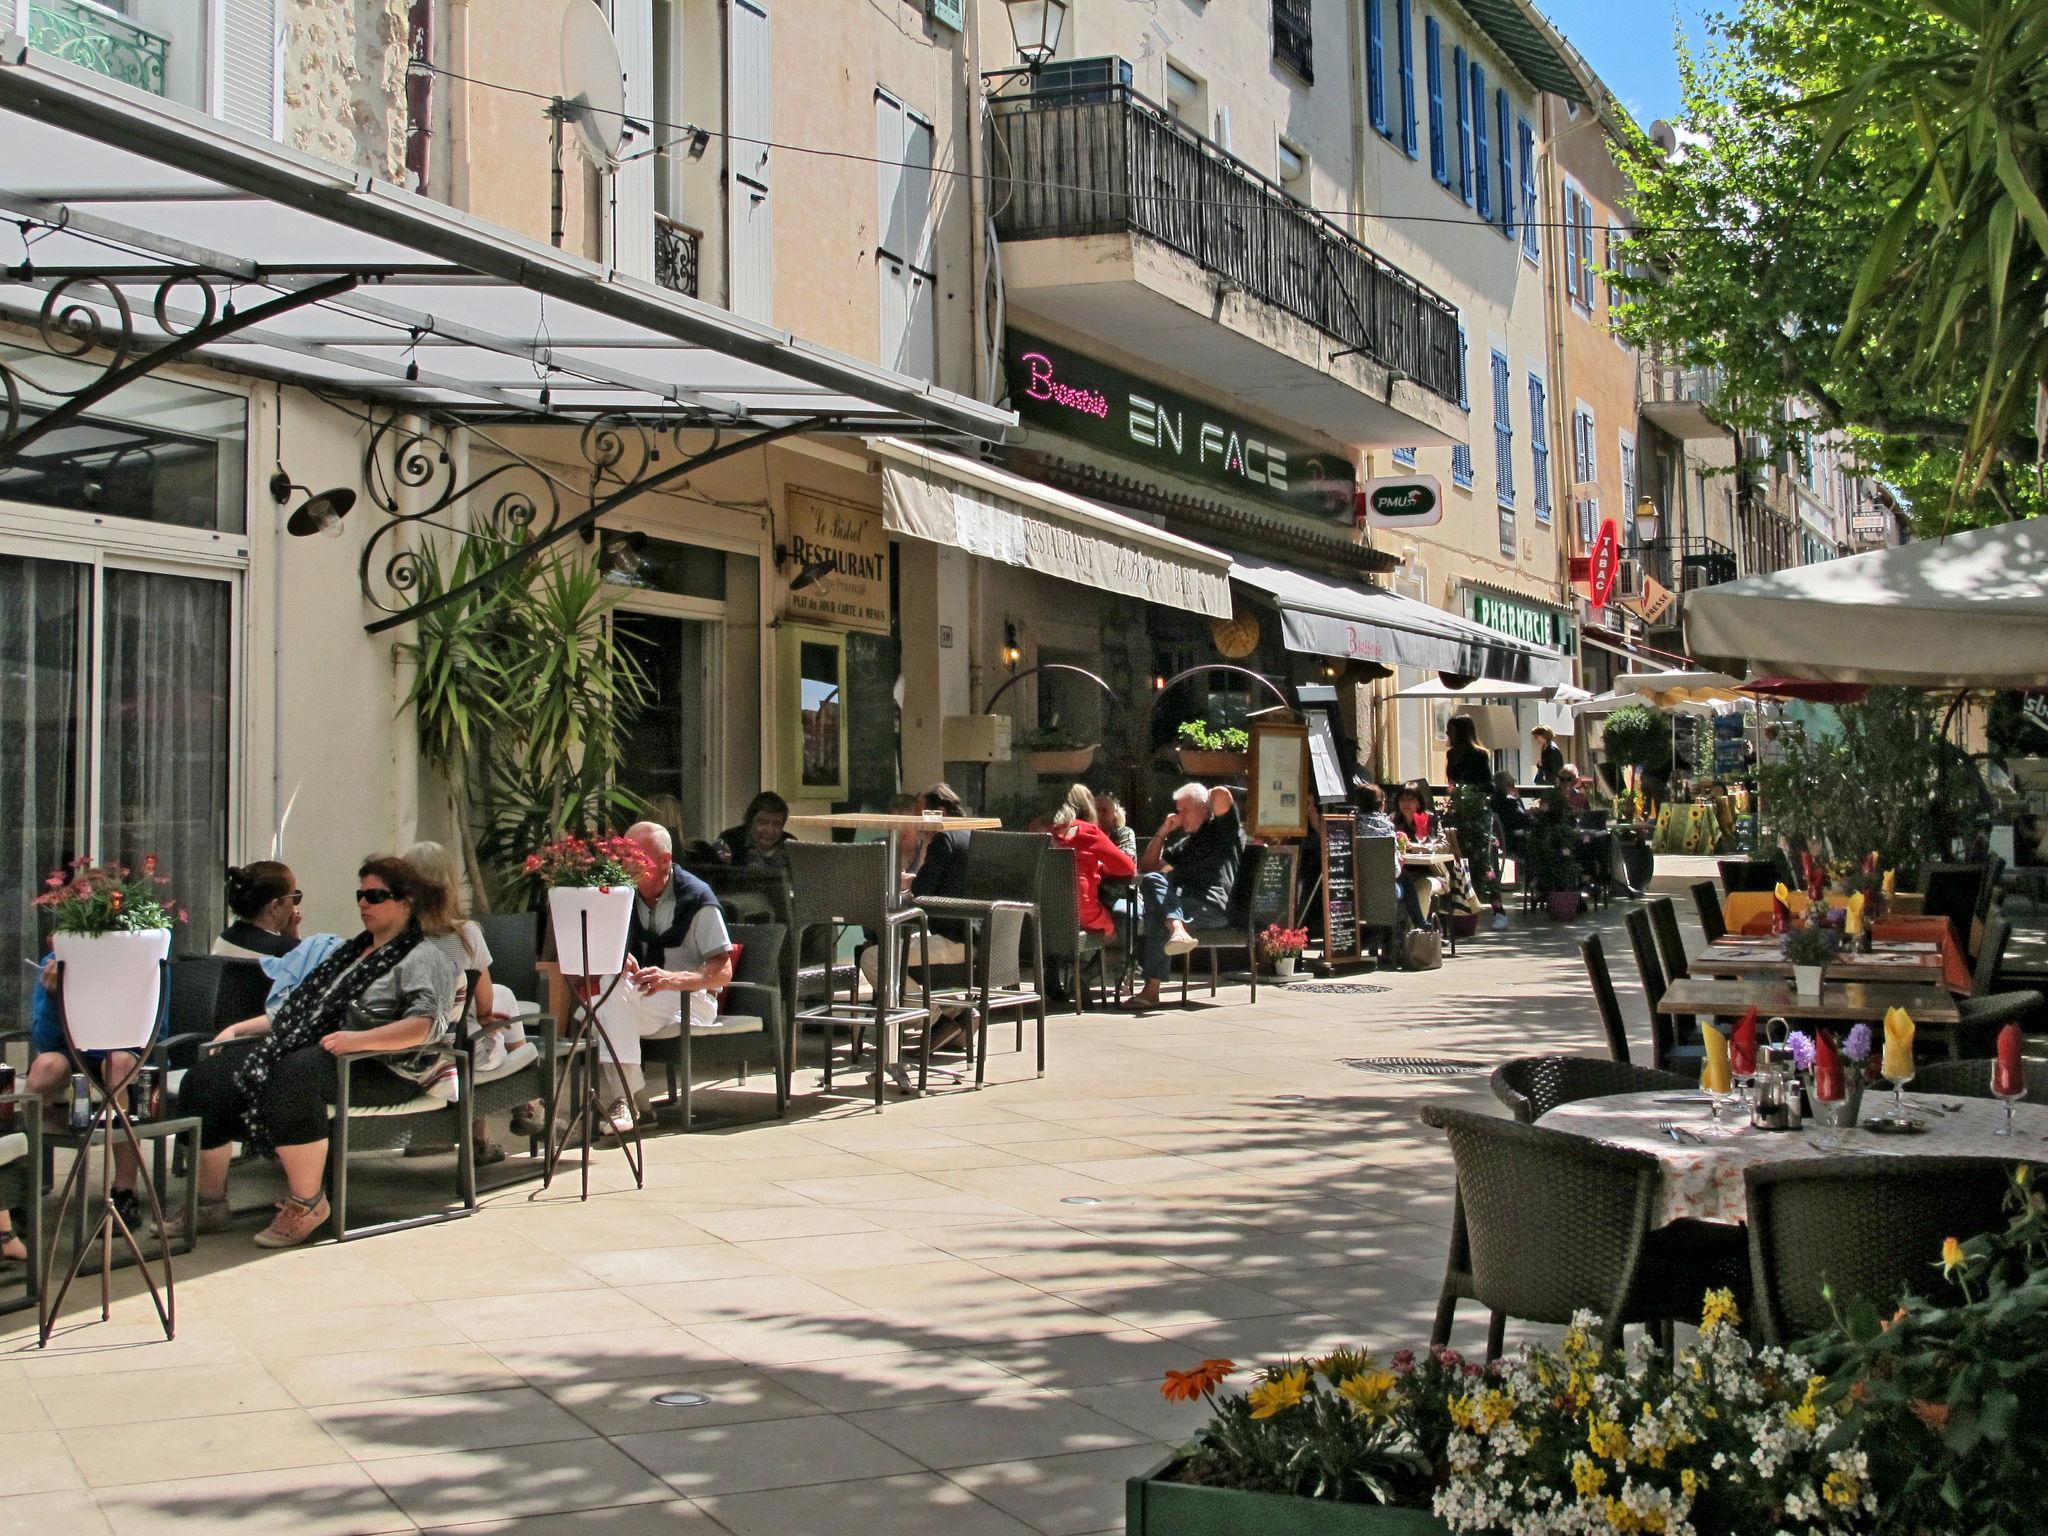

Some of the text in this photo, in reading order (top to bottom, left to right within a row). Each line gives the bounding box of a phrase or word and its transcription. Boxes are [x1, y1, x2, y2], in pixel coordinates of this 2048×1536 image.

[1129, 393, 1184, 456] EN
[1200, 422, 1288, 492] FACE
[1377, 496, 1408, 509] PMU
[792, 534, 884, 582] RESTAURANT
[1023, 516, 1093, 569] RESTAURANT
[1595, 536, 1612, 591] TABAC
[1481, 597, 1551, 647] PHARMACIE
[1644, 592, 1670, 620] PRESSE
